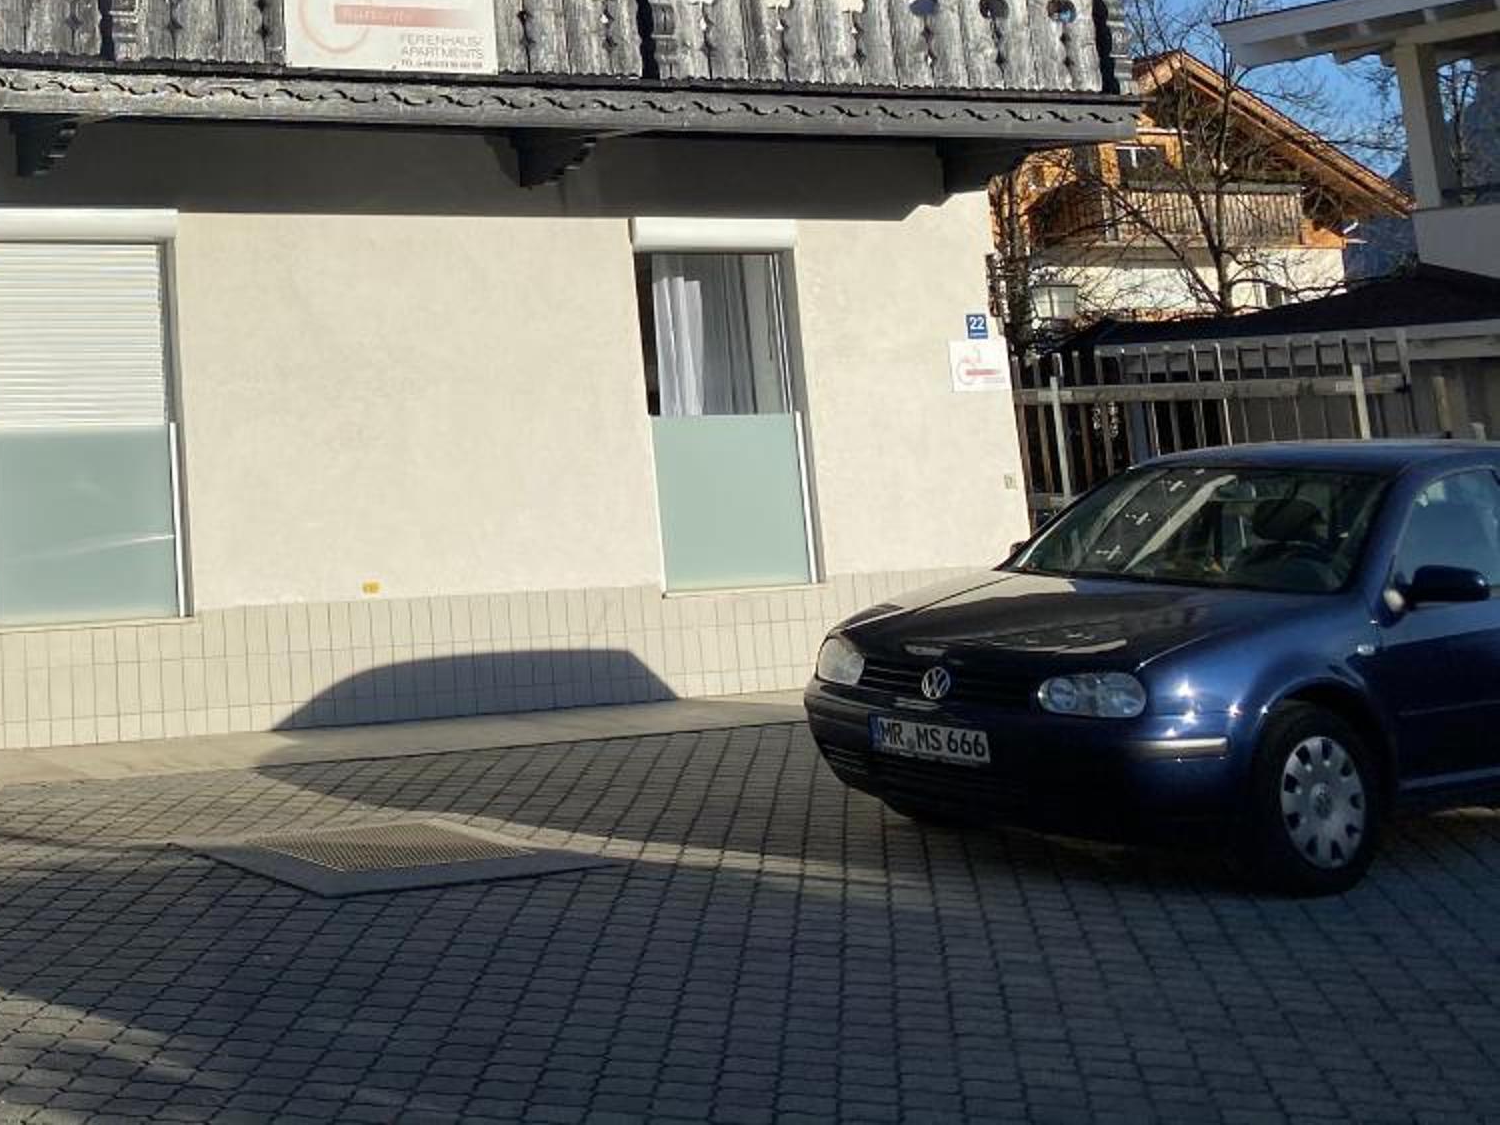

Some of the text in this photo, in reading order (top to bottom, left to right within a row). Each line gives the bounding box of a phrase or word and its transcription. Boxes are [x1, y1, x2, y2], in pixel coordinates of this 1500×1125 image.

[969, 317, 985, 330] 22
[879, 720, 987, 758] MR MS 666
